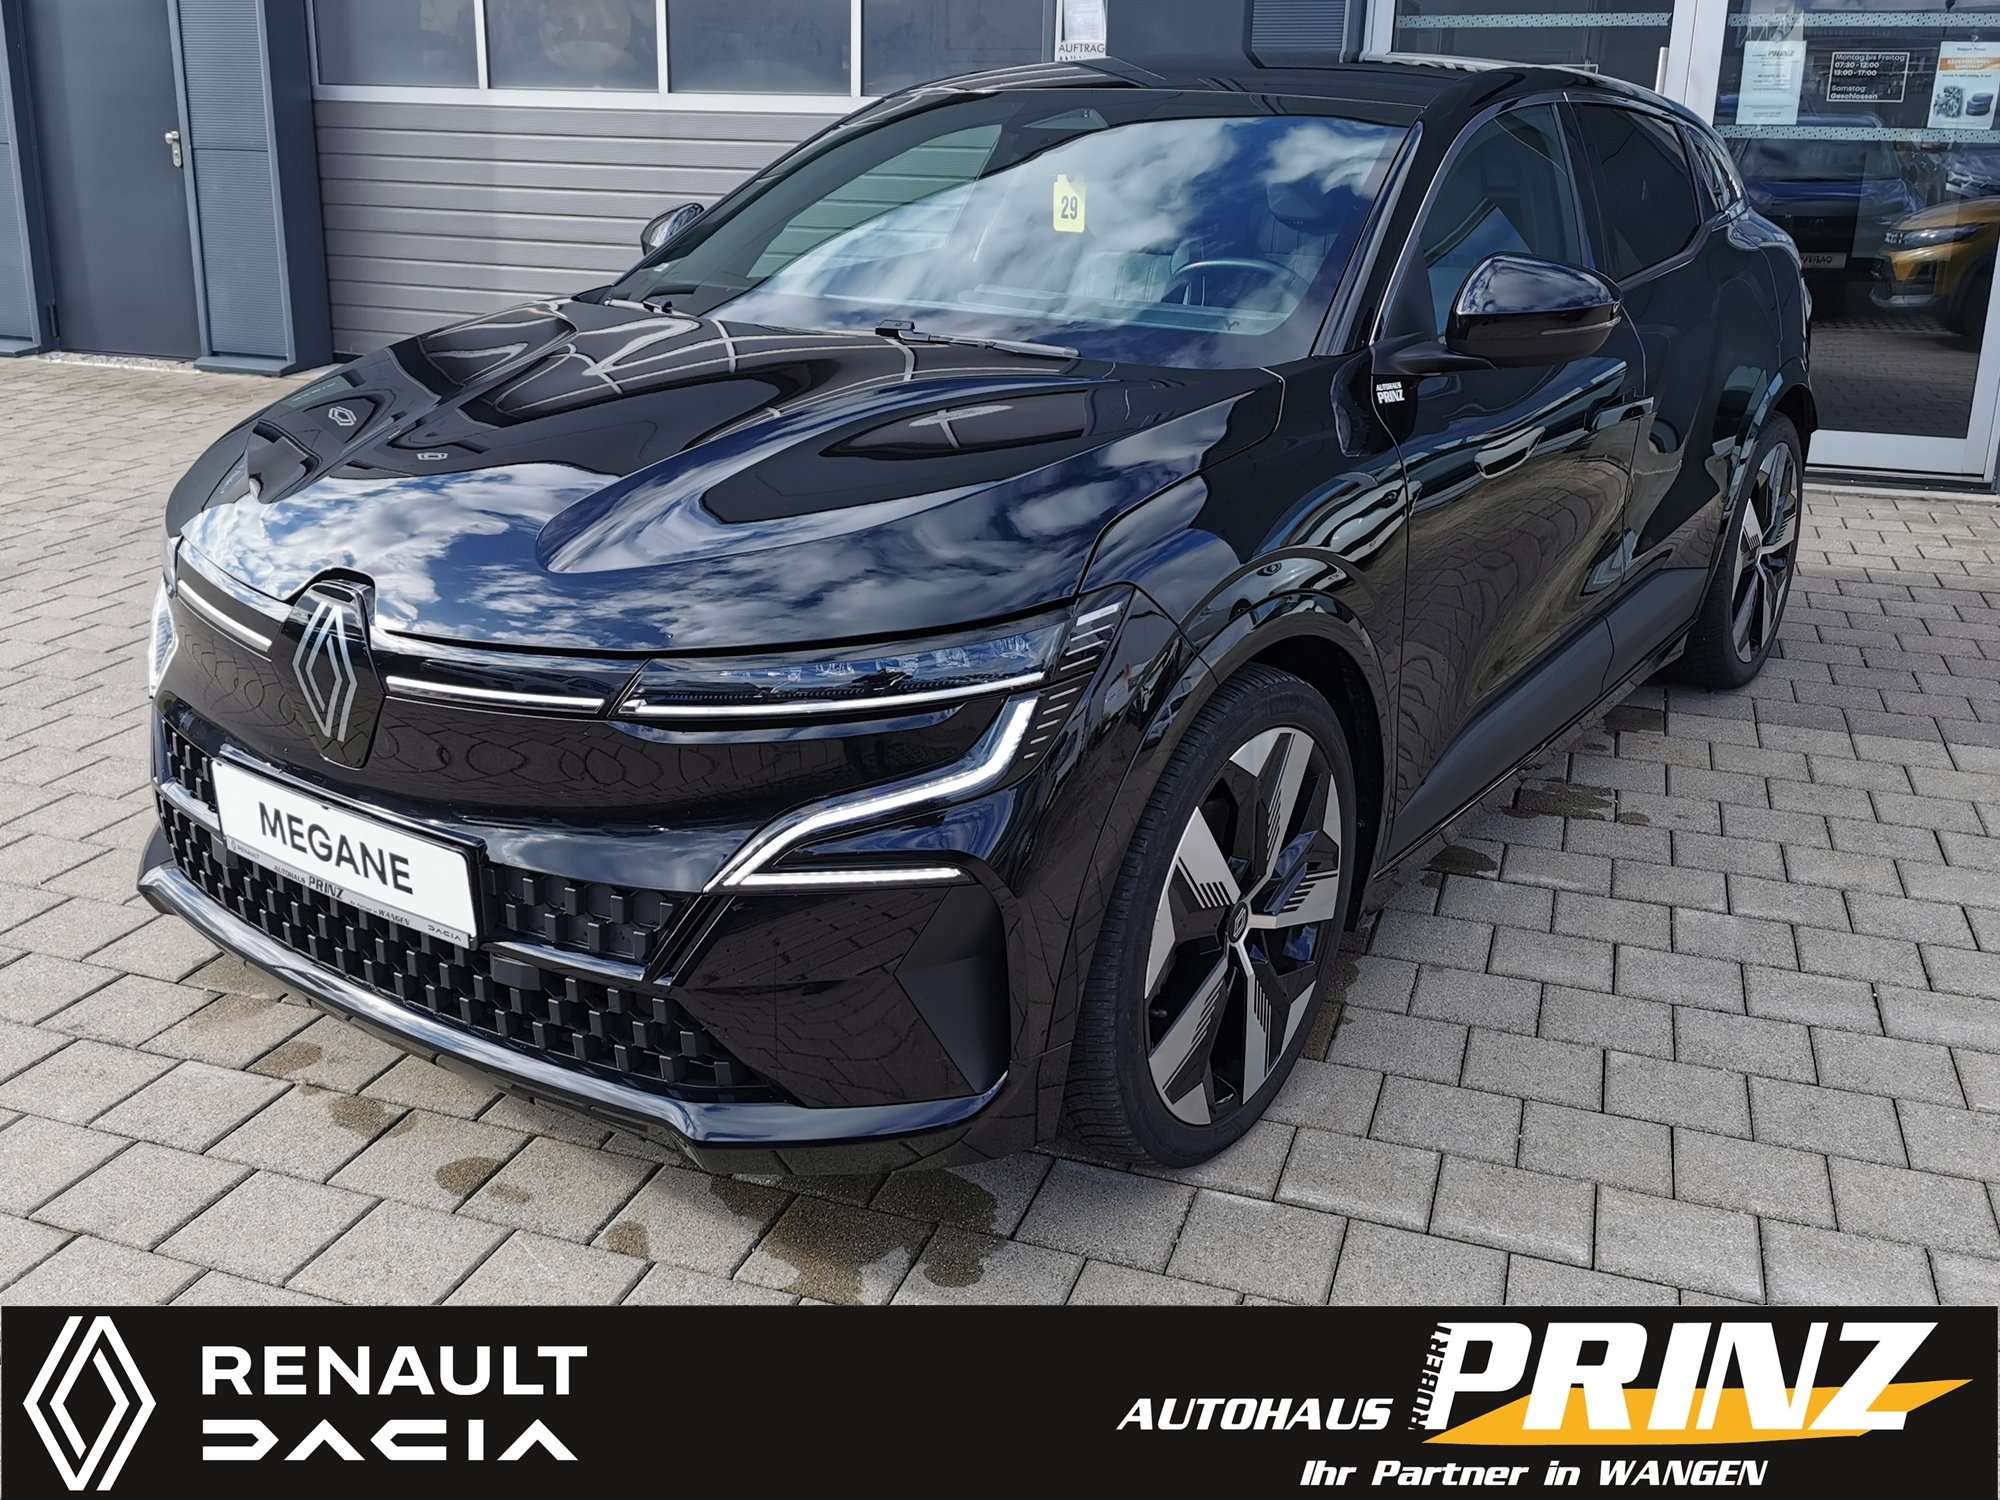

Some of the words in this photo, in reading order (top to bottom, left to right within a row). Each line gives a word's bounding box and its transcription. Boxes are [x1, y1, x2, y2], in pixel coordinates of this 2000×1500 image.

[1058, 43, 1105, 53] AUFTRAG
[1835, 54, 1864, 62] Montag
[1878, 54, 1905, 62] Freitag
[1830, 92, 1878, 100] Geschlossen
[1060, 195, 1079, 220] 29
[1376, 389, 1405, 404] PRINZ
[258, 801, 414, 895] MEGANE
[308, 875, 345, 900] PRINZ
[427, 924, 462, 941] DACIA
